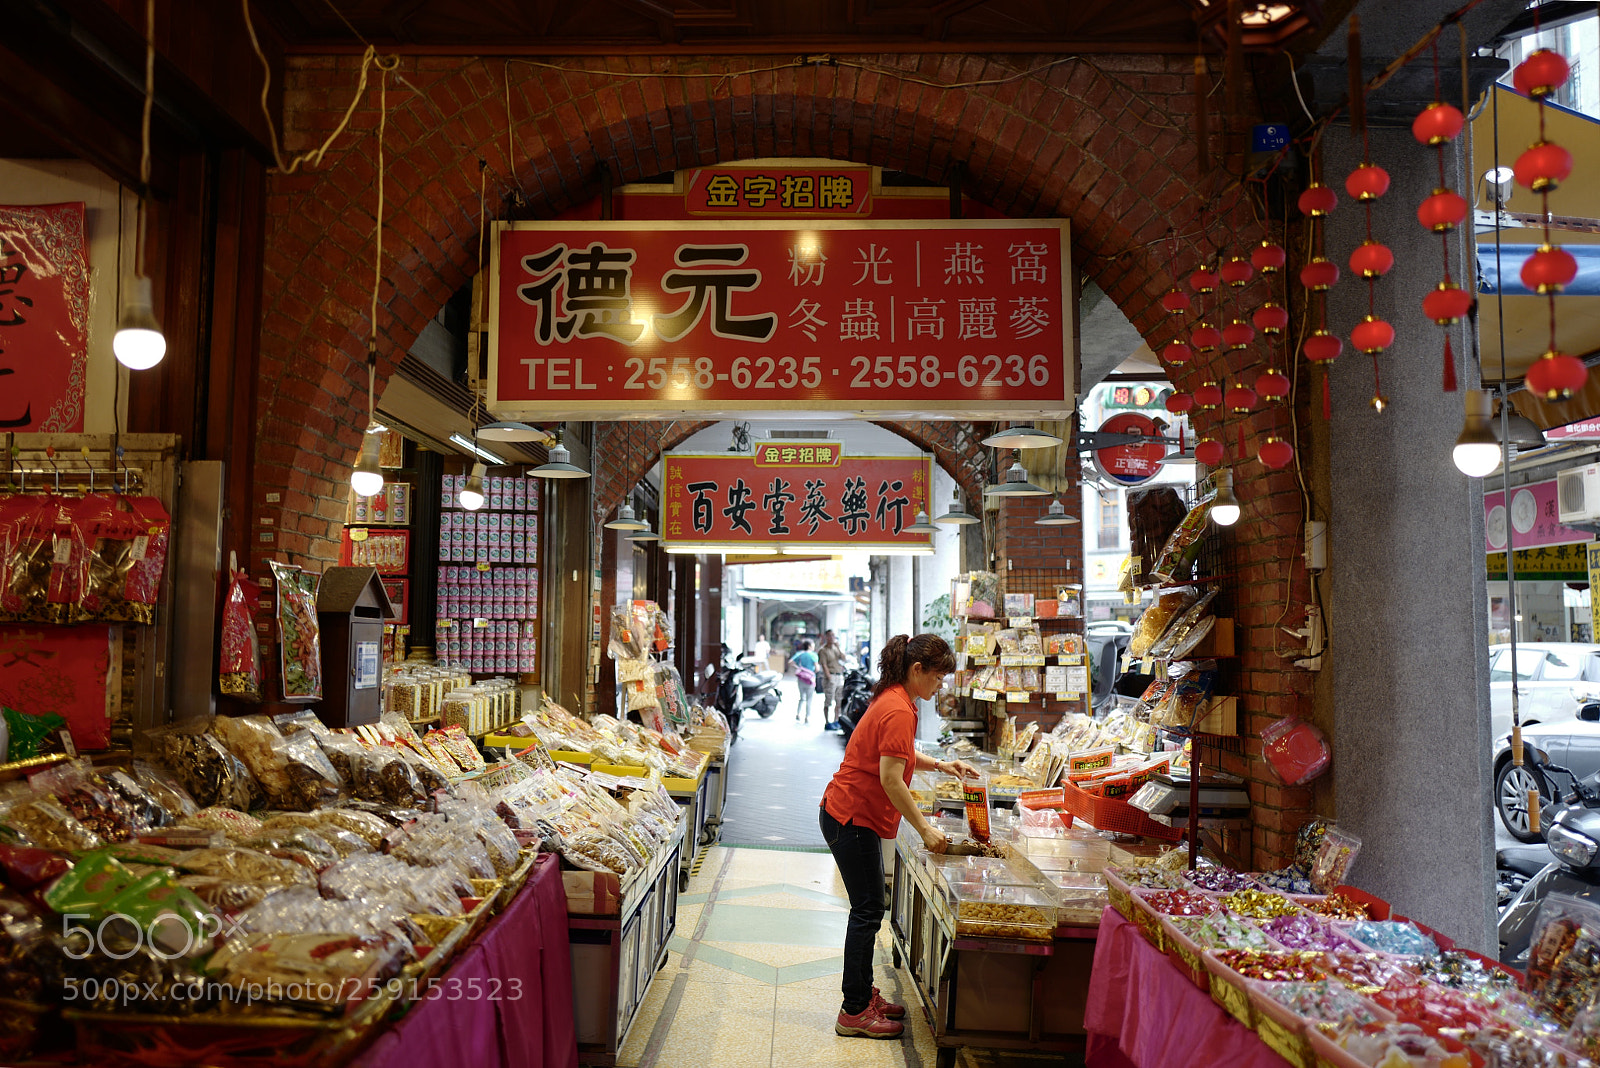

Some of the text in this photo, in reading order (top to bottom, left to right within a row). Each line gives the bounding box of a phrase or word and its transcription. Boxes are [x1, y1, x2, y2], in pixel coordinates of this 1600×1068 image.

[705, 174, 855, 209] 金字招牌
[517, 241, 778, 347] 德元
[850, 354, 1051, 389] 2558-6236
[764, 446, 832, 464] 金字招牌
[669, 465, 684, 536] 誠信實在
[687, 475, 911, 537] 百安堂蔘藥行
